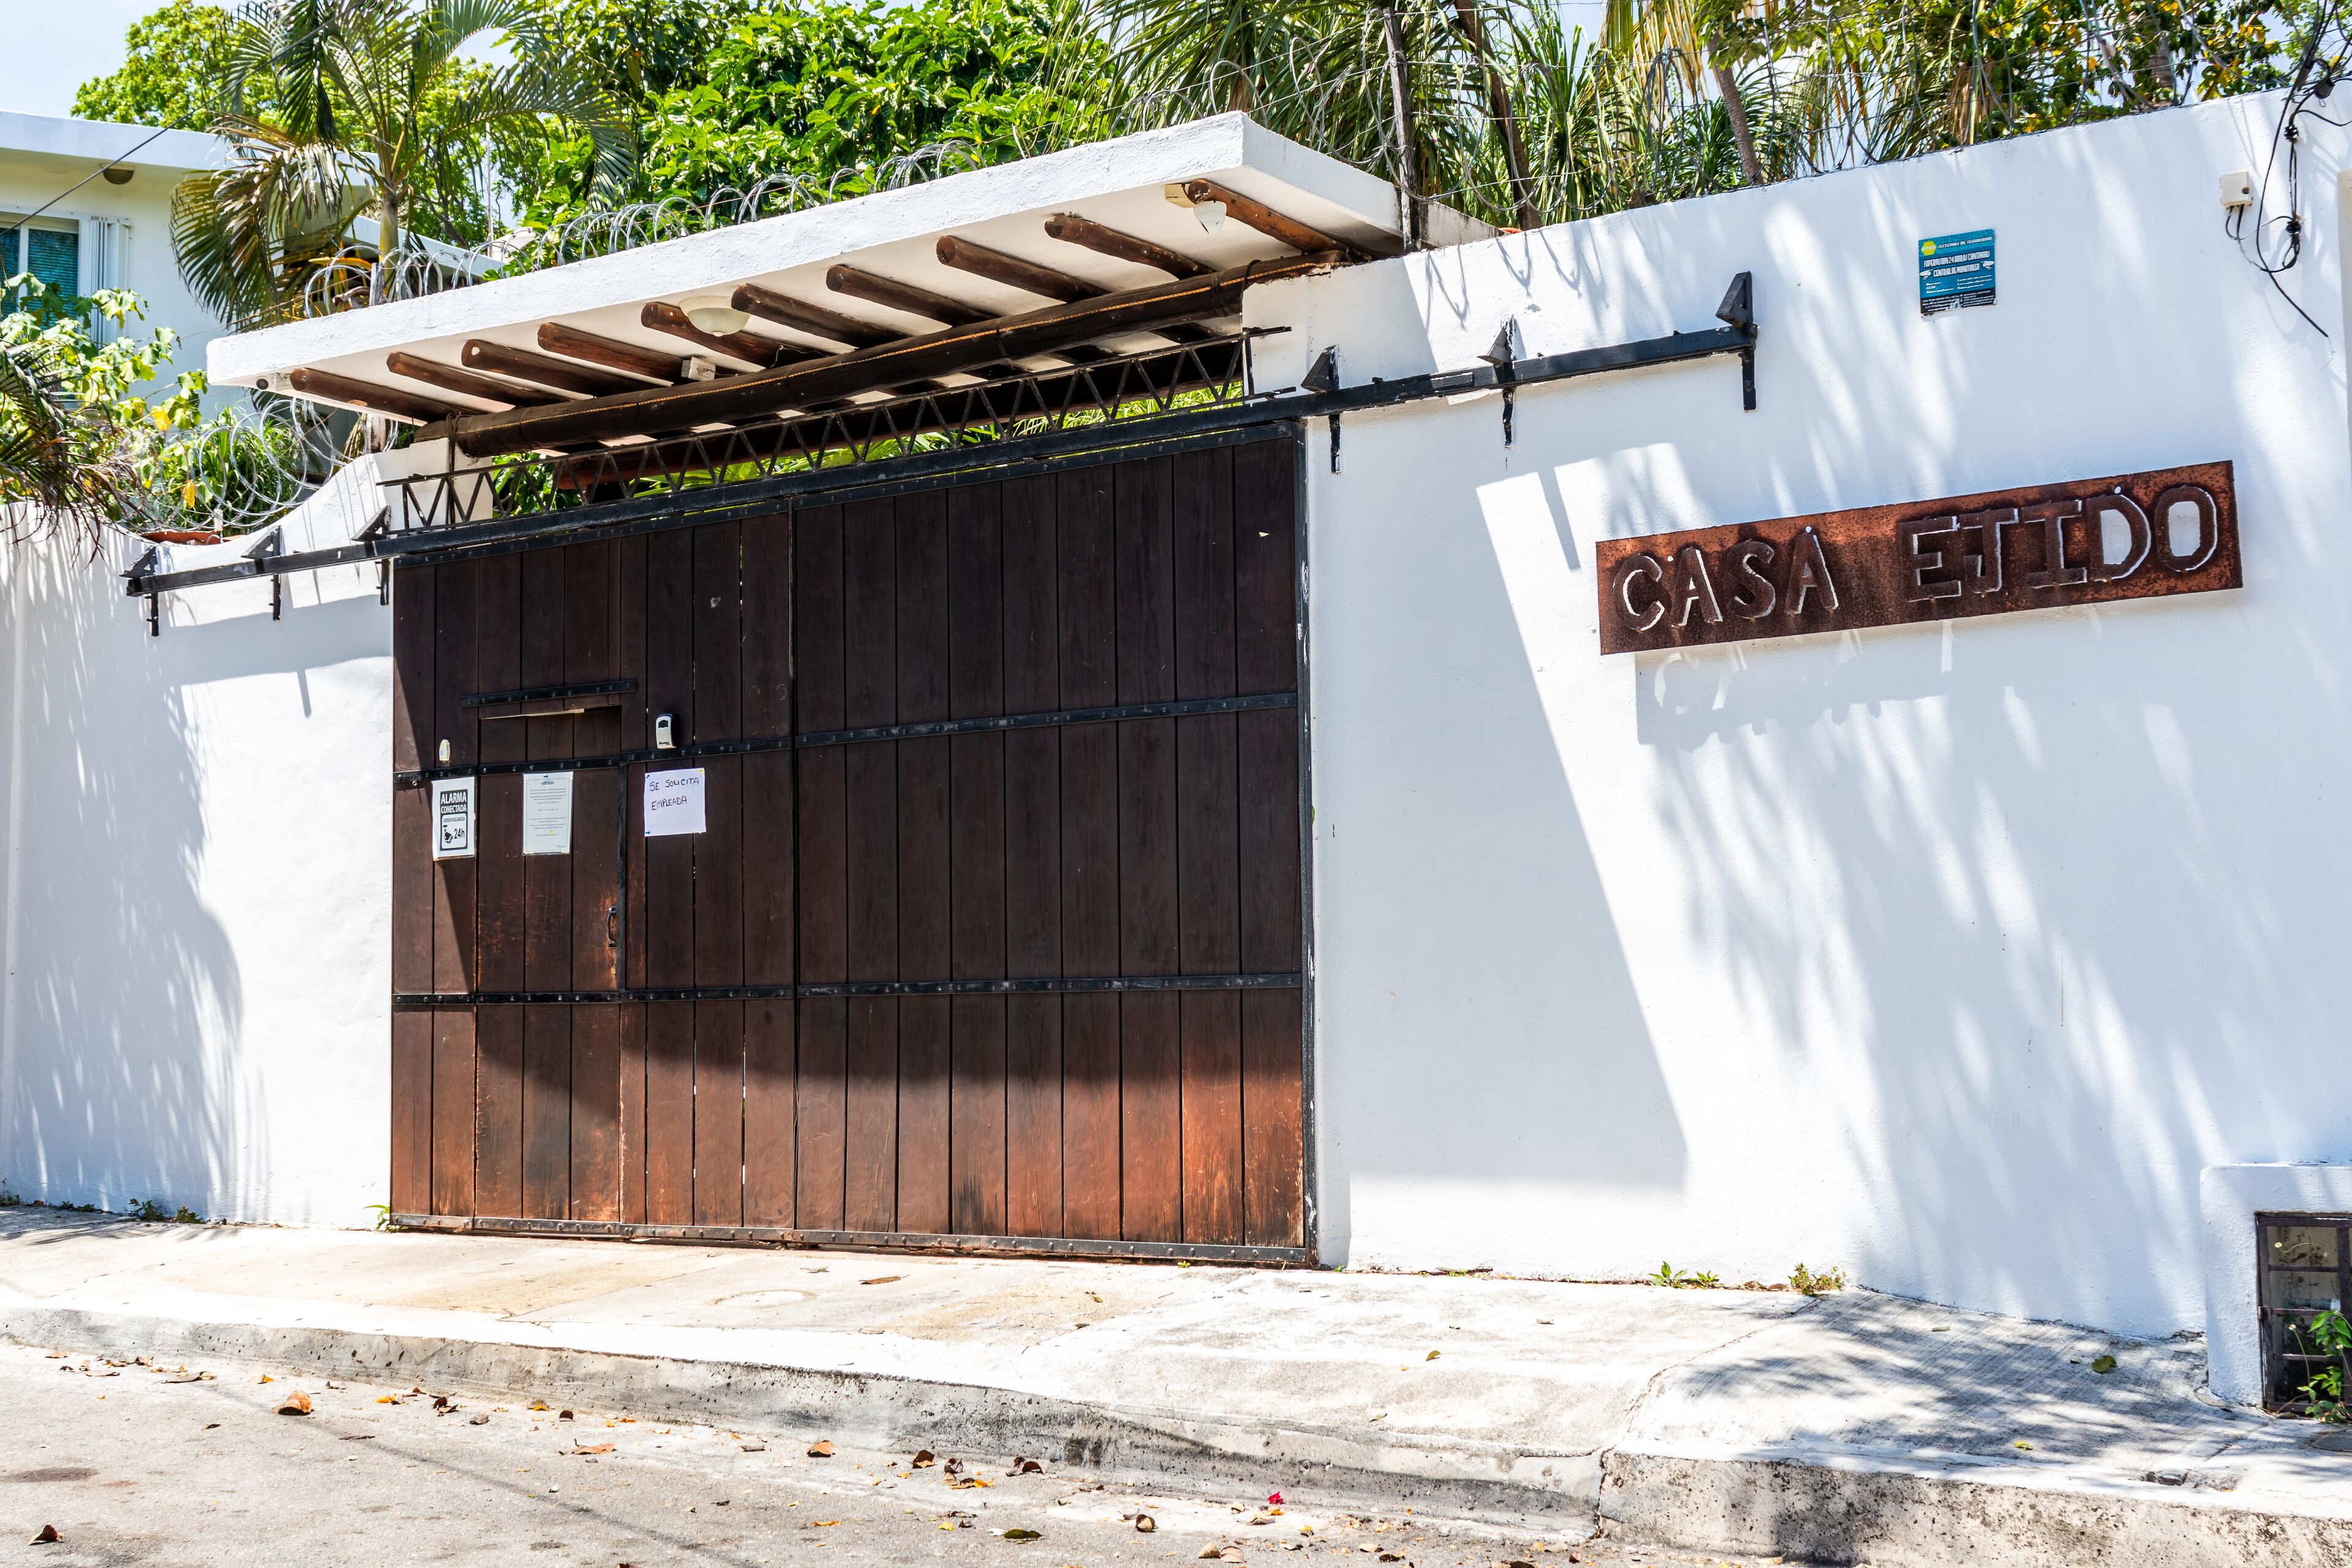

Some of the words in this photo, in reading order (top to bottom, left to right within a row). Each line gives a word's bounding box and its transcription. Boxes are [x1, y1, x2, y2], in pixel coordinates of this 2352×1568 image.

[1613, 526, 1840, 631] CASA
[1897, 485, 2218, 601] EJIDO
[649, 781, 660, 791] SE
[665, 777, 699, 788] SOLICITA
[440, 791, 467, 805] ALARMA
[651, 795, 687, 810] EMPLEADA
[440, 804, 467, 814] CONECTADA
[454, 828, 465, 839] 24h
